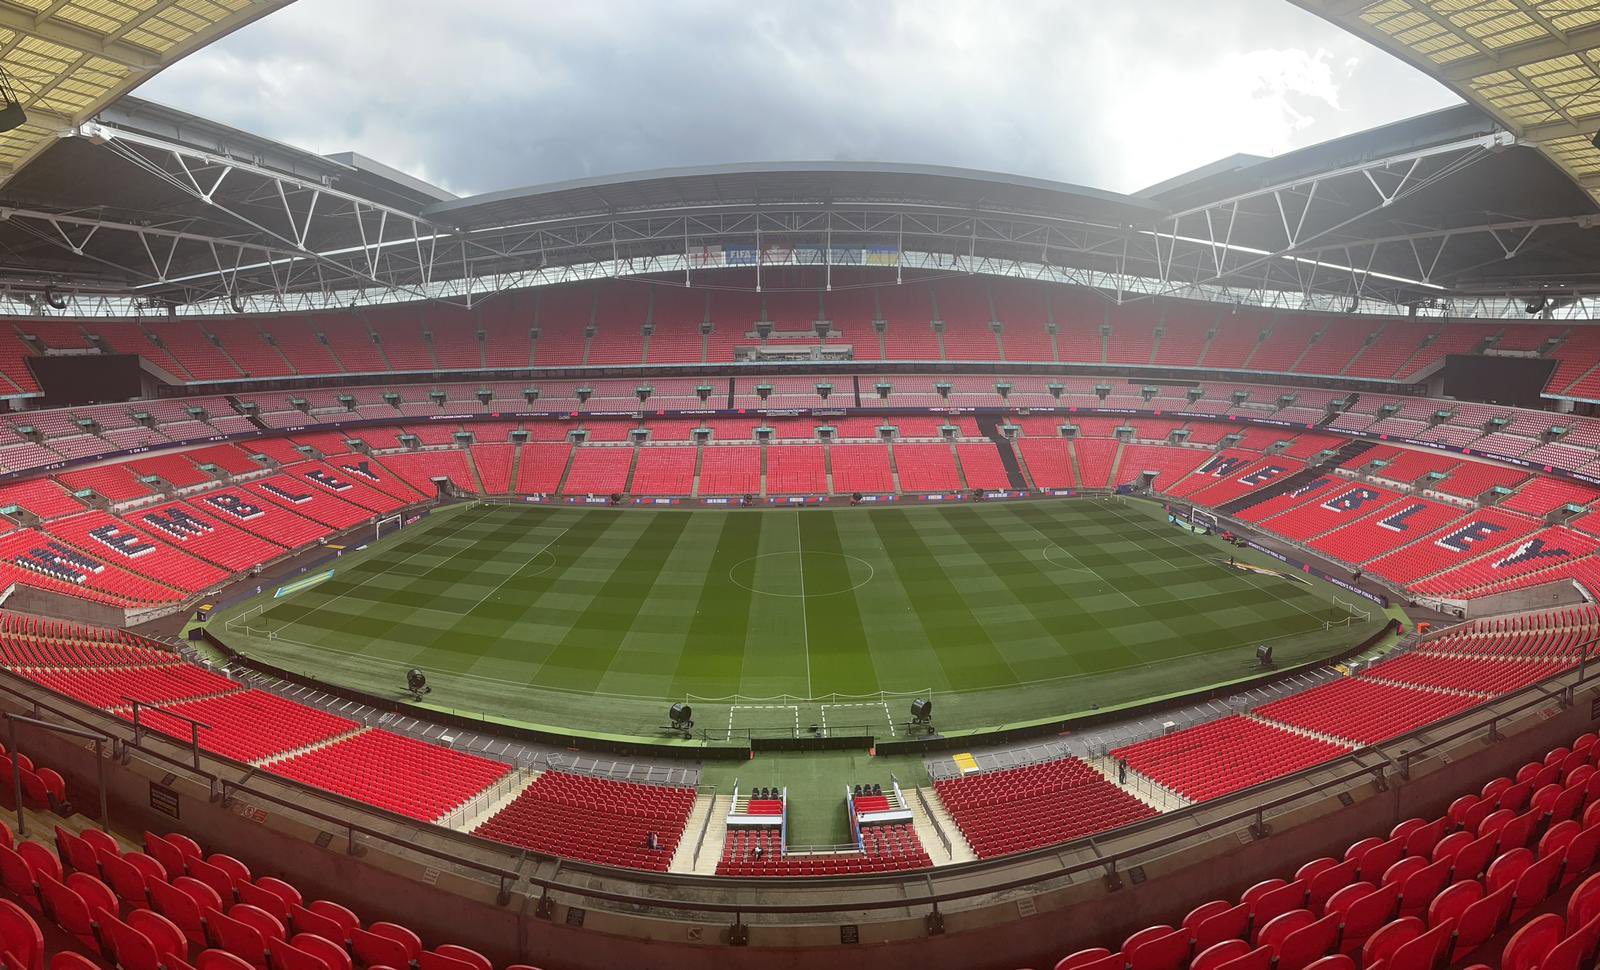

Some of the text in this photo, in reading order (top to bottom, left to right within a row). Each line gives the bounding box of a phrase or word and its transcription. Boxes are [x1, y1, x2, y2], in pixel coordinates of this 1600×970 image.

[730, 250, 752, 258] FIFA
[16, 462, 380, 584] WEMBLEY
[1332, 578, 1348, 589] WOMEN'S
[1362, 591, 1373, 600] FINAL
